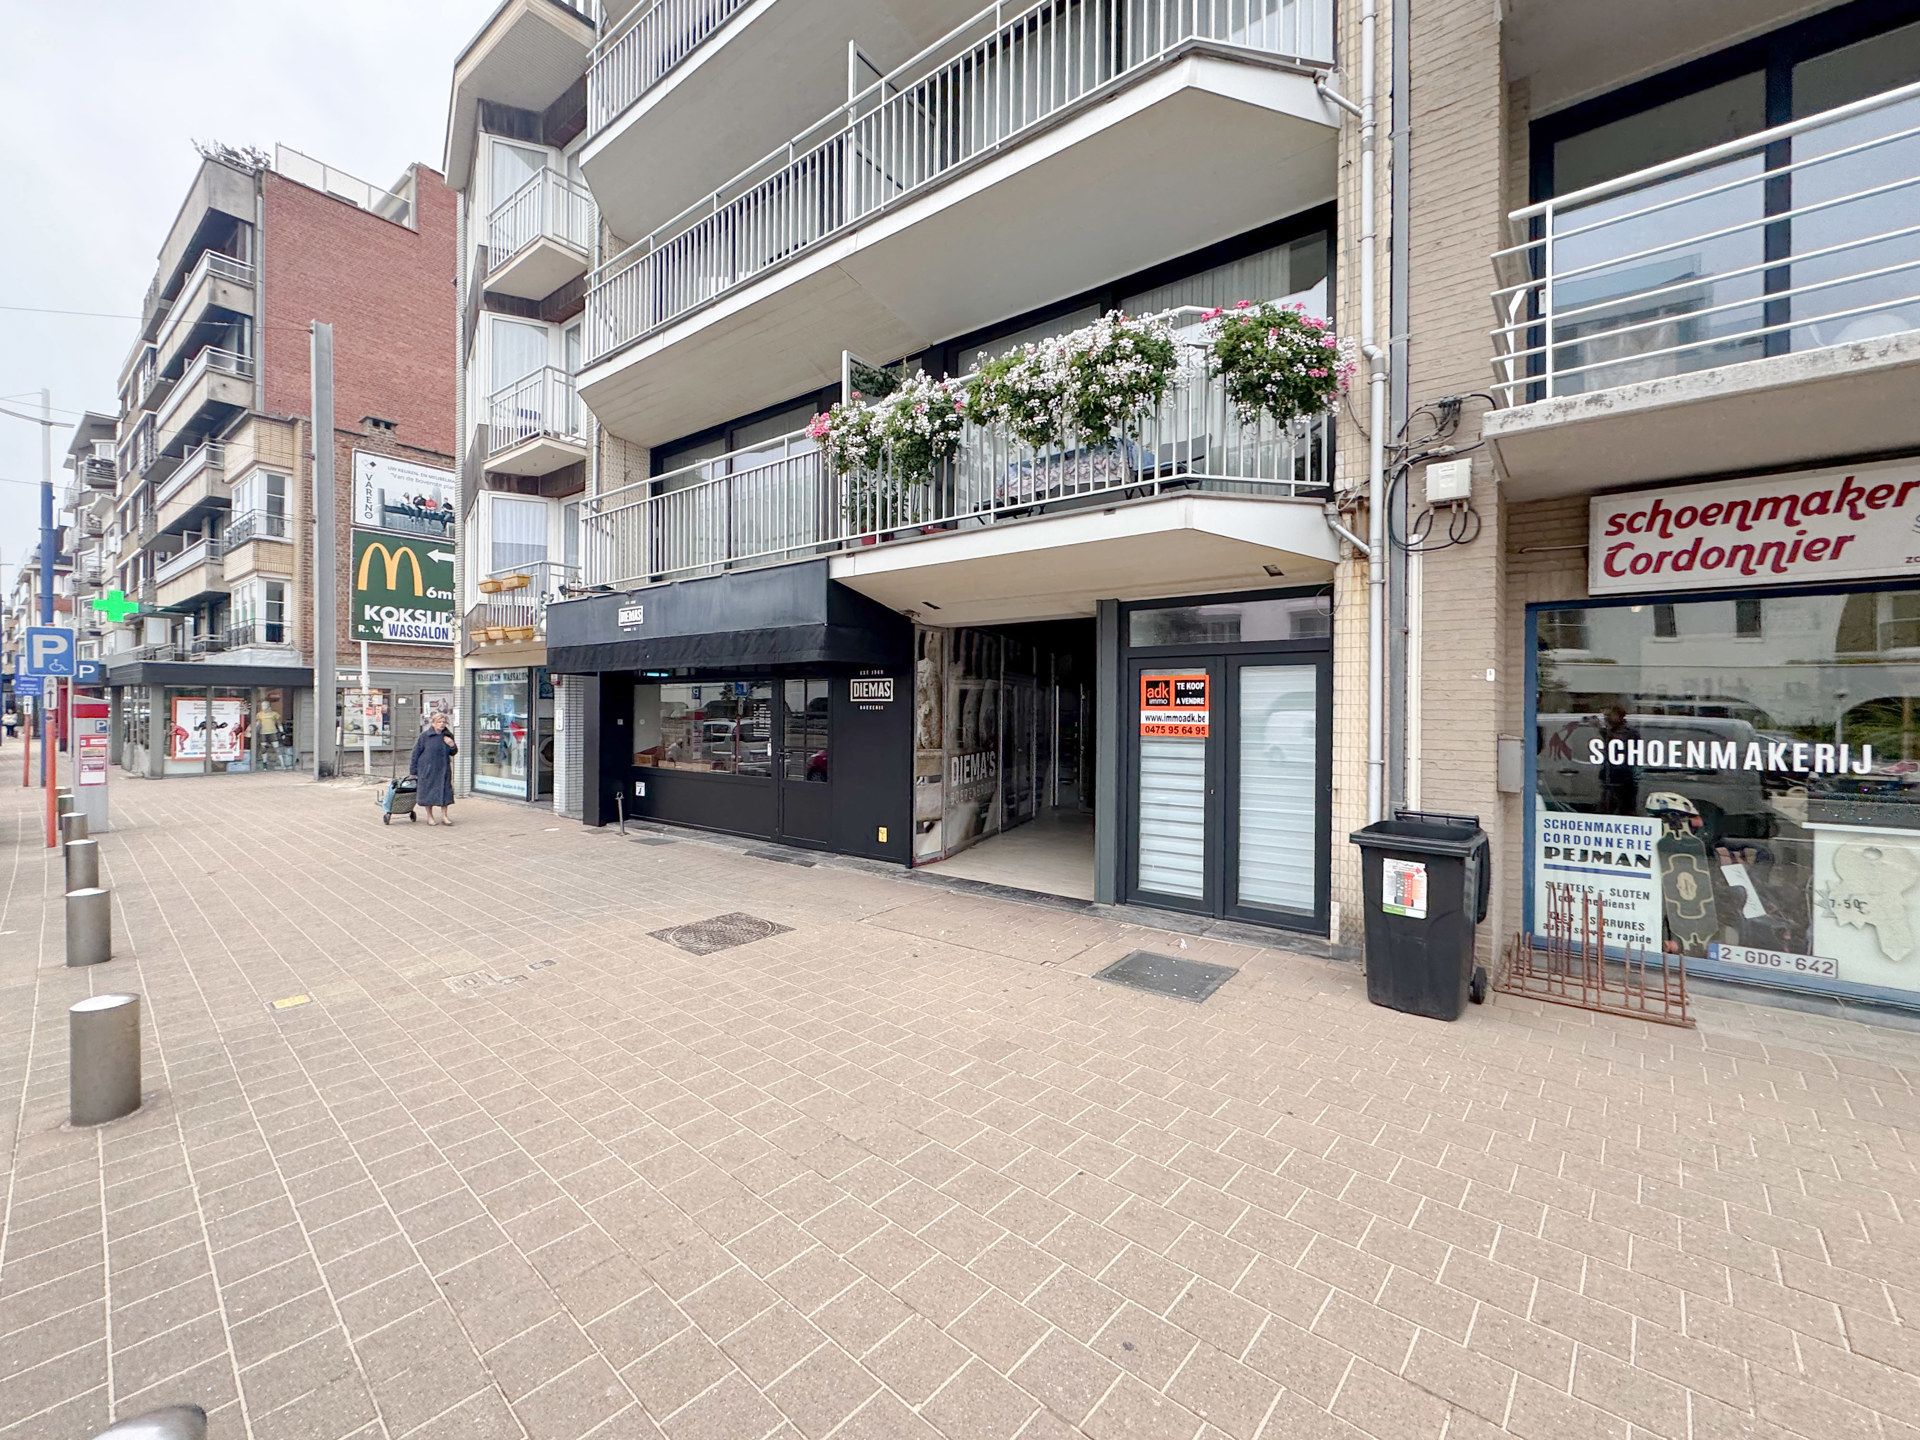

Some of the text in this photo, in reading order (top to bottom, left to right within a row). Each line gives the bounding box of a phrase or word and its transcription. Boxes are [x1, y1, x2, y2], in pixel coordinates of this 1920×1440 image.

[365, 473, 374, 519] VARENO
[1604, 530, 1856, 578] Cordonnier
[389, 624, 449, 640] WASSALON
[32, 634, 68, 668] P
[79, 665, 95, 678] P
[854, 682, 890, 697] DIEMAS
[1147, 682, 1204, 698] adk TE KOOP
[480, 717, 501, 730] Wash
[1145, 713, 1205, 722] www.immoadk.be
[1145, 726, 1206, 735] 0475 95 64 95
[1589, 738, 1872, 775] SCHOENMAKERIJ
[951, 751, 996, 786] DIEMA'S
[1544, 819, 1652, 836] SCHOENMAKERIJ
[1544, 833, 1651, 851] CORDONNERIE
[1544, 846, 1651, 868] PEJMAN
[1545, 881, 1594, 894] SETELS
[1610, 888, 1650, 900] SLOTEN
[1581, 898, 1635, 910] nedienst
[1590, 917, 1645, 931] SRRURES
[1617, 933, 1652, 944] rapide
